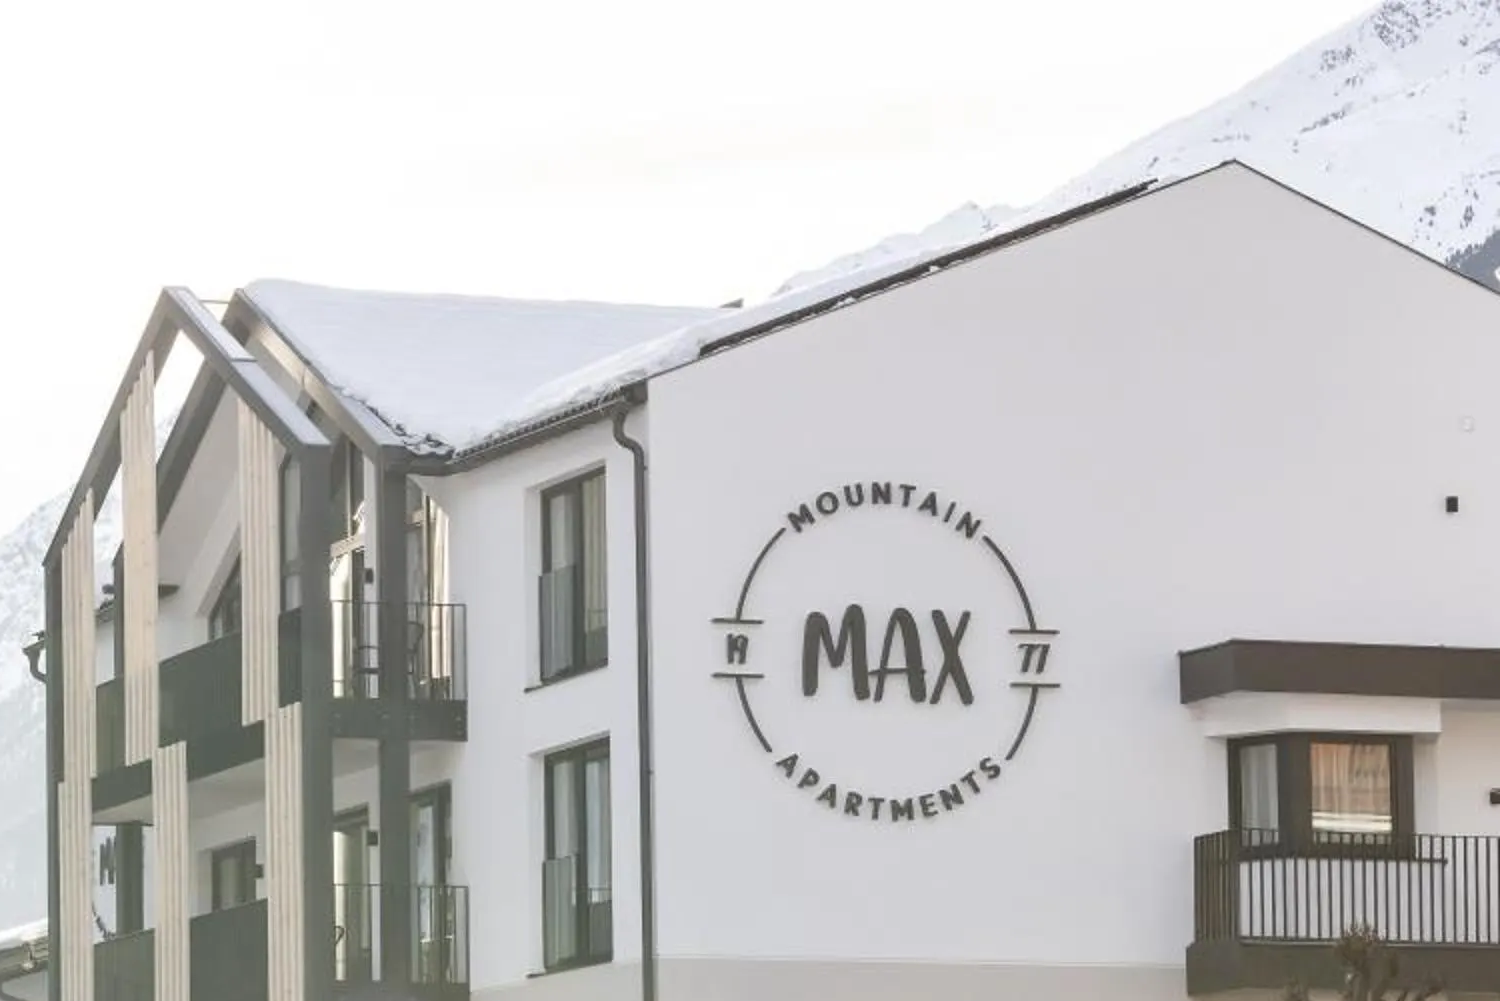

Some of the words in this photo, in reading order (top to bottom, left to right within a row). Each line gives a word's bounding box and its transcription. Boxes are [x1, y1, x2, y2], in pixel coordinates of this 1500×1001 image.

[787, 481, 982, 539] MOUNTAIN
[802, 604, 975, 705] MAX
[1018, 642, 1051, 674] 77
[775, 752, 1002, 823] APARTMENTS
